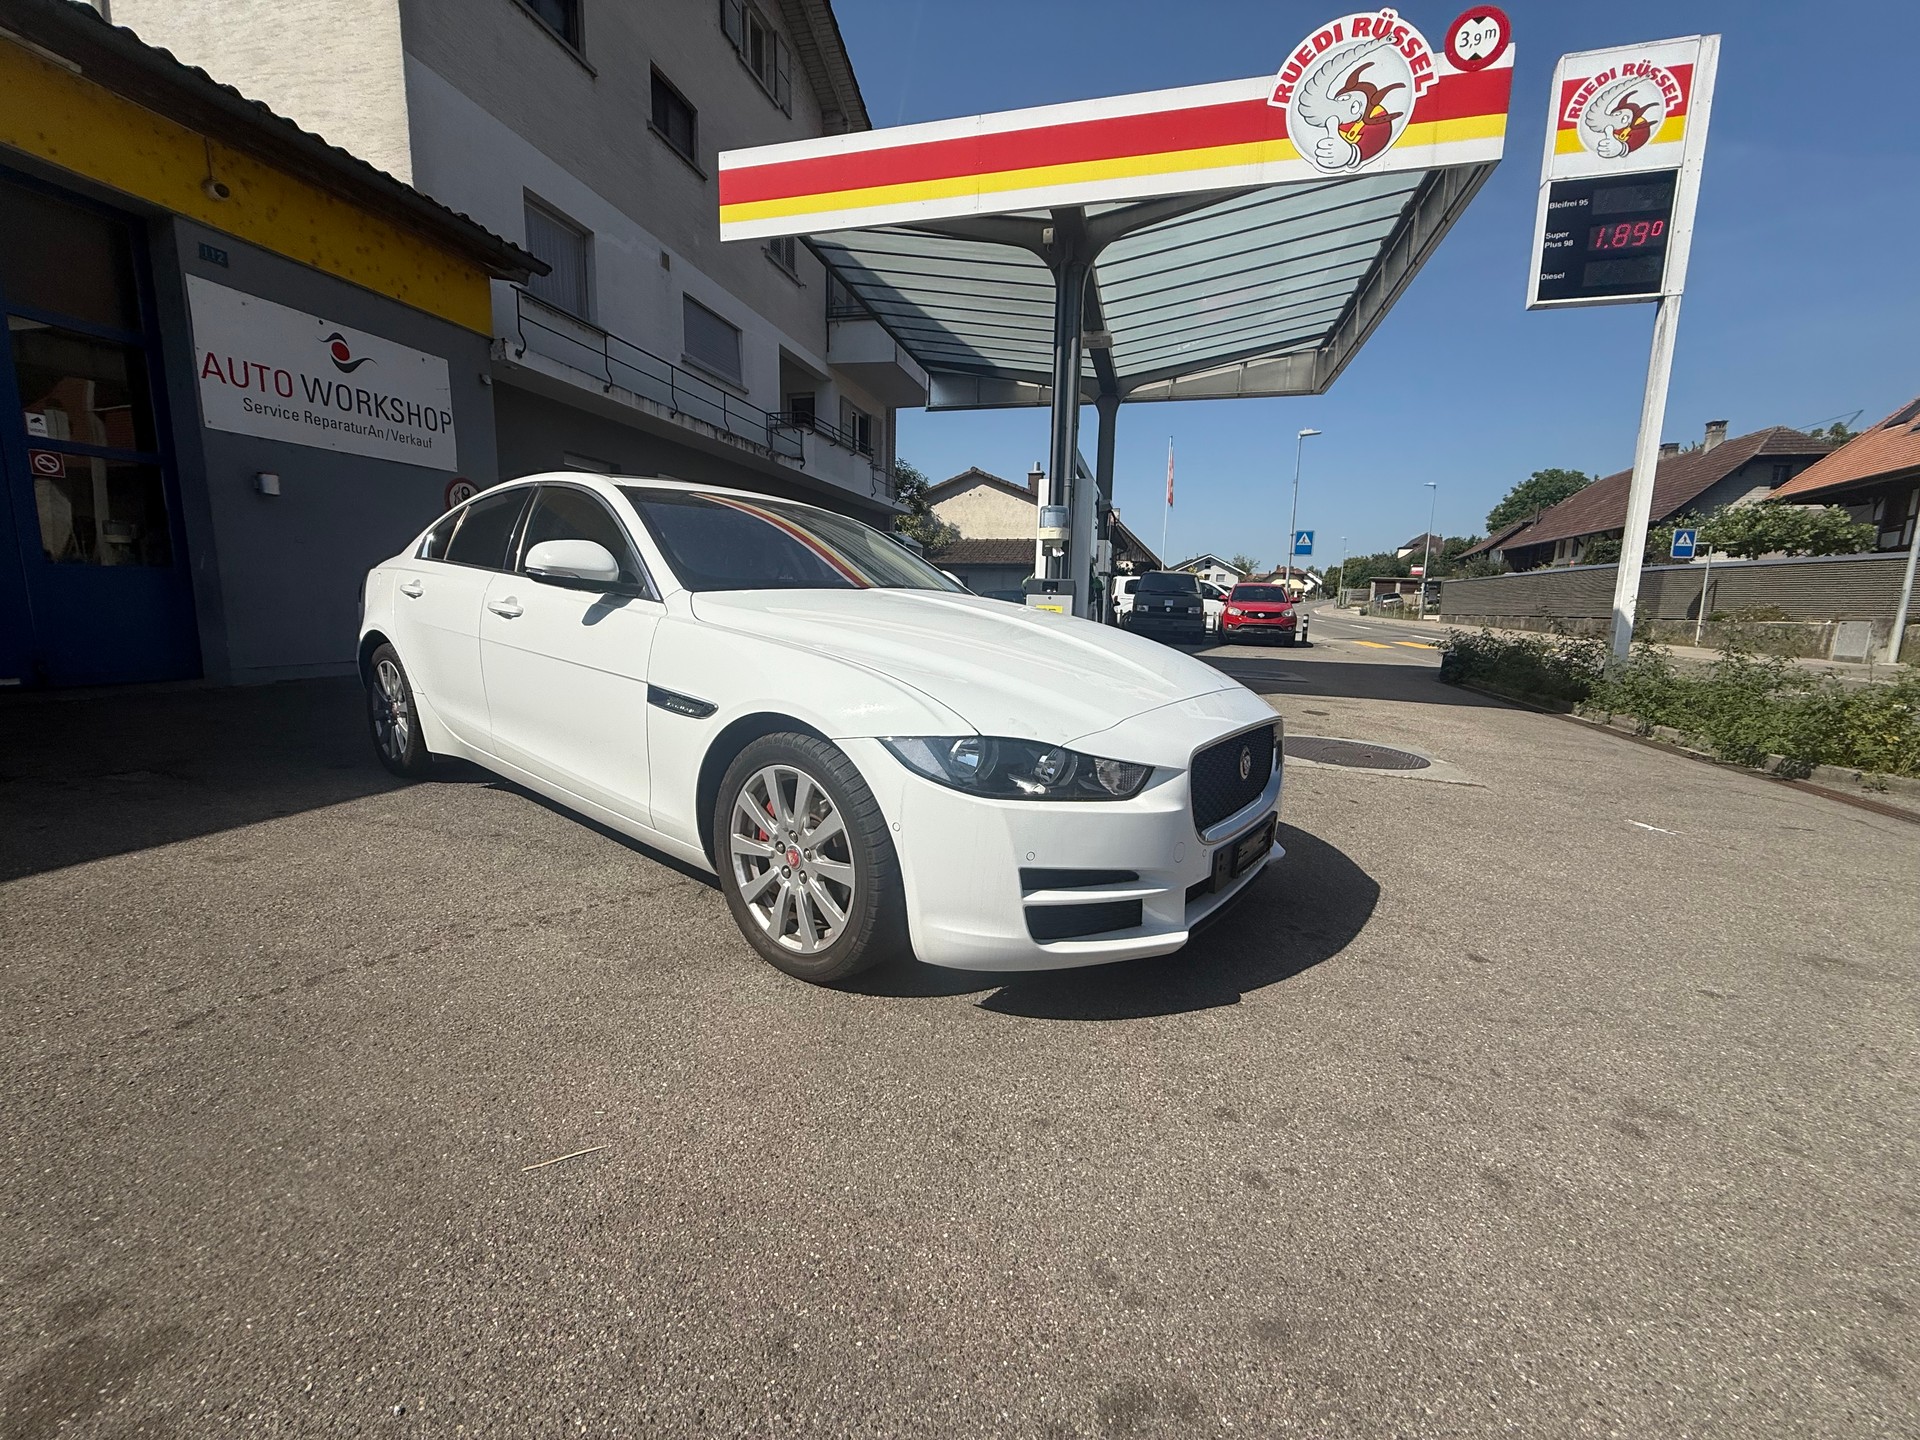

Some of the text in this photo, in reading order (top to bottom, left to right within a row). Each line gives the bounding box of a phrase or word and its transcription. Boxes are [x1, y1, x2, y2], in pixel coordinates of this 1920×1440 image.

[1459, 31, 1482, 49] 3,9
[1272, 11, 1436, 104] RUEDI RÜSSEL
[1567, 59, 1680, 120] RUEDI RÜSSEL
[1549, 198, 1589, 209] Bleifrei 95
[1544, 239, 1574, 248] Plus 98
[1545, 230, 1570, 240] Super
[1540, 271, 1565, 280] Diesel
[201, 351, 453, 435] AUTO WORKSHOP
[243, 396, 300, 422] Service
